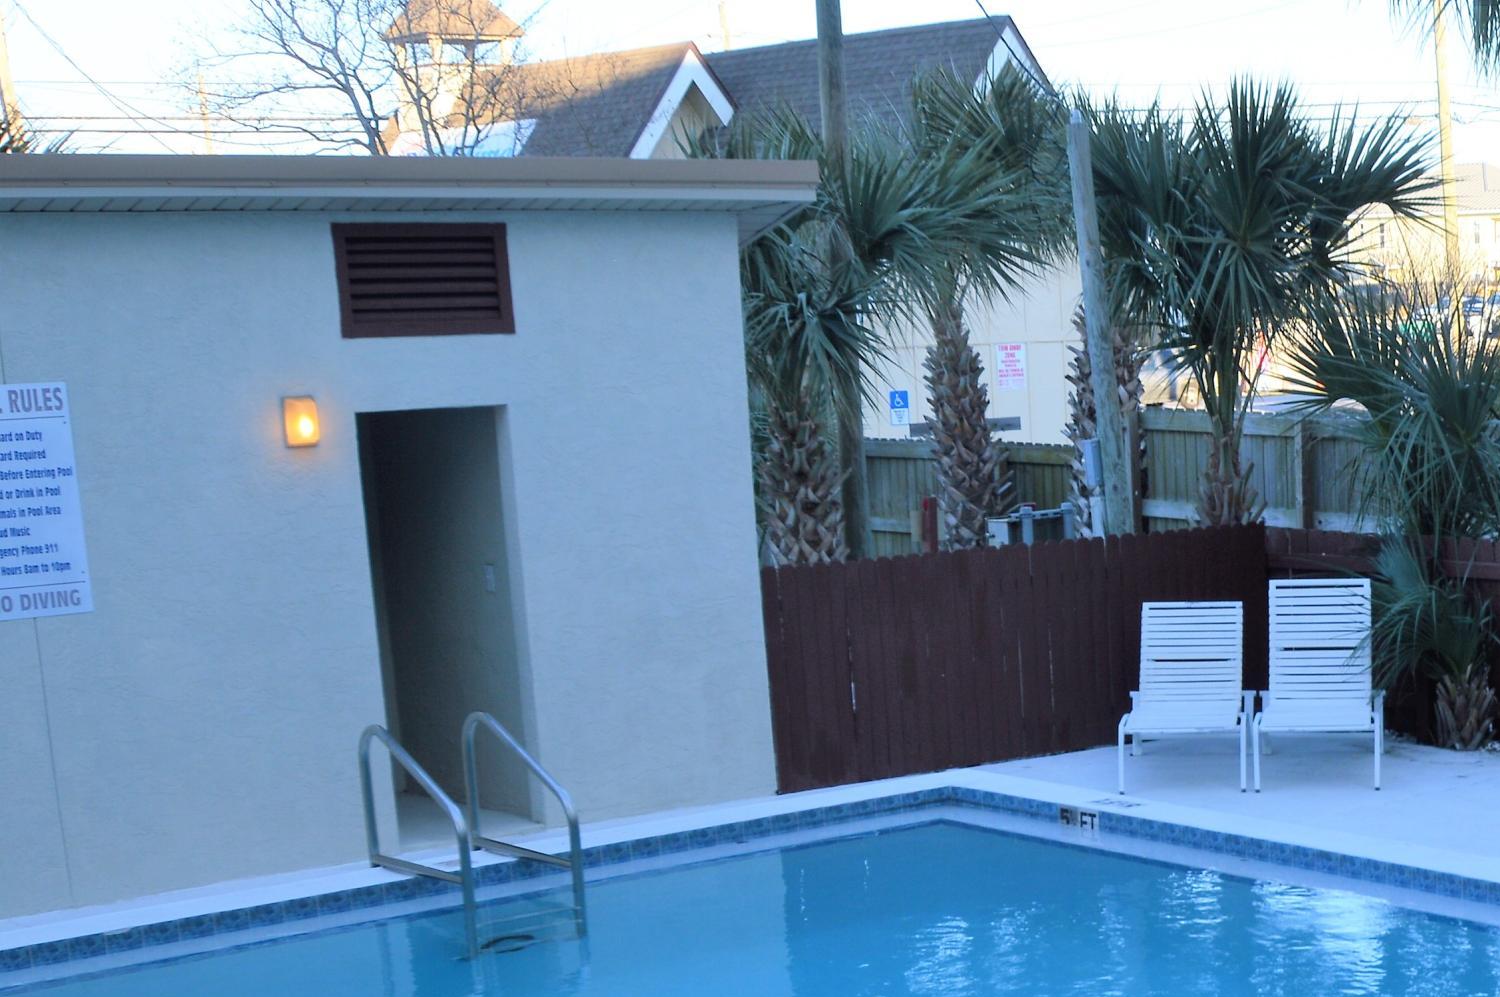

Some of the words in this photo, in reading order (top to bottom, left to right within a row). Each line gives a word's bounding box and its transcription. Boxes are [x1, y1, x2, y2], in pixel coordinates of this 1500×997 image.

[8, 387, 63, 413] RULES
[15, 432, 24, 441] on
[26, 430, 42, 442] Duty
[14, 449, 46, 462] Required
[25, 468, 56, 480] Entering
[57, 466, 73, 477] Pool
[15, 488, 35, 498] Drink
[36, 487, 43, 497] in
[45, 486, 61, 497] Pool
[28, 506, 43, 517] Pool
[45, 505, 61, 515] Area
[9, 526, 30, 537] Music
[21, 545, 43, 556] Phone
[44, 543, 58, 553] 911
[1, 566, 22, 576] Hours
[40, 563, 49, 573] to
[51, 561, 71, 573] 10pm
[20, 589, 82, 612] DIVING
[1080, 811, 1097, 830] FT
